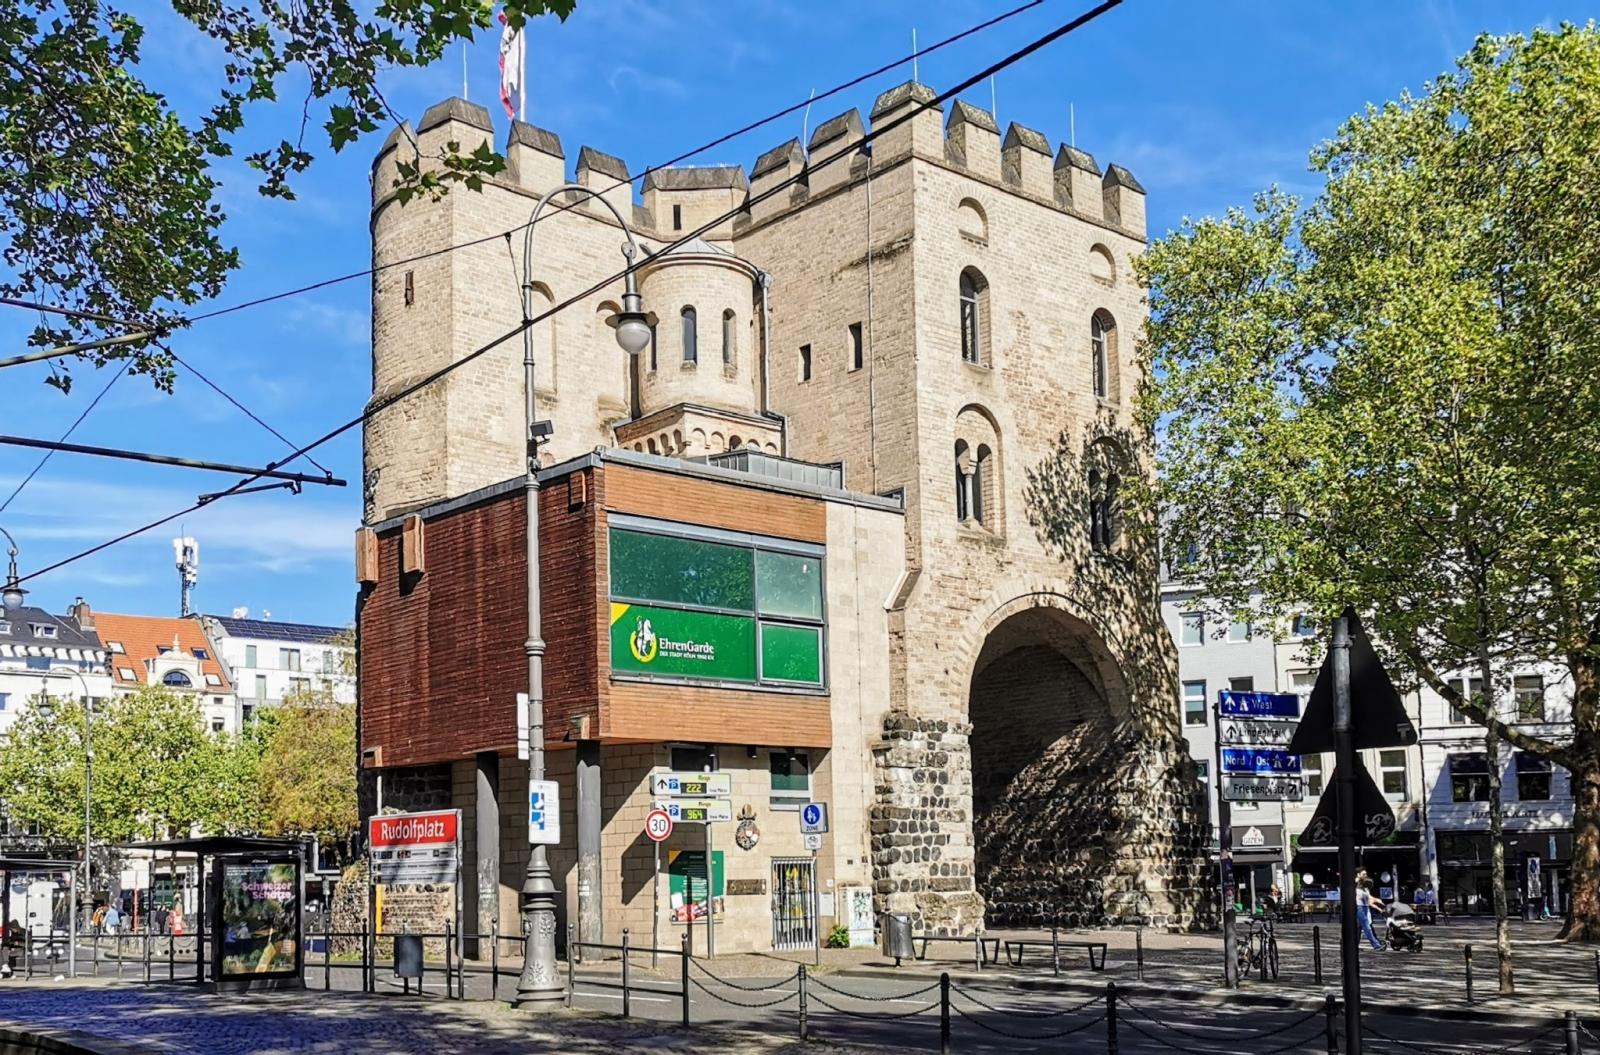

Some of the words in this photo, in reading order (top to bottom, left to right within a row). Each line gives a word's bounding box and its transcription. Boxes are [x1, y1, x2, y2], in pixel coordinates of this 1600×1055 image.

[659, 638, 714, 654] EhrenGarde
[1252, 698, 1273, 710] West
[1239, 726, 1282, 738] Lindenthal
[1225, 755, 1246, 766] Nord
[1256, 755, 1270, 767] Ost
[686, 784, 701, 793] 222
[1233, 783, 1285, 796] Friesenplatz
[687, 810, 703, 820] 964
[381, 818, 445, 843] Rudolfplatz
[651, 819, 666, 832] 30
[241, 881, 293, 891] Schweizer
[252, 889, 292, 900] Schätze
